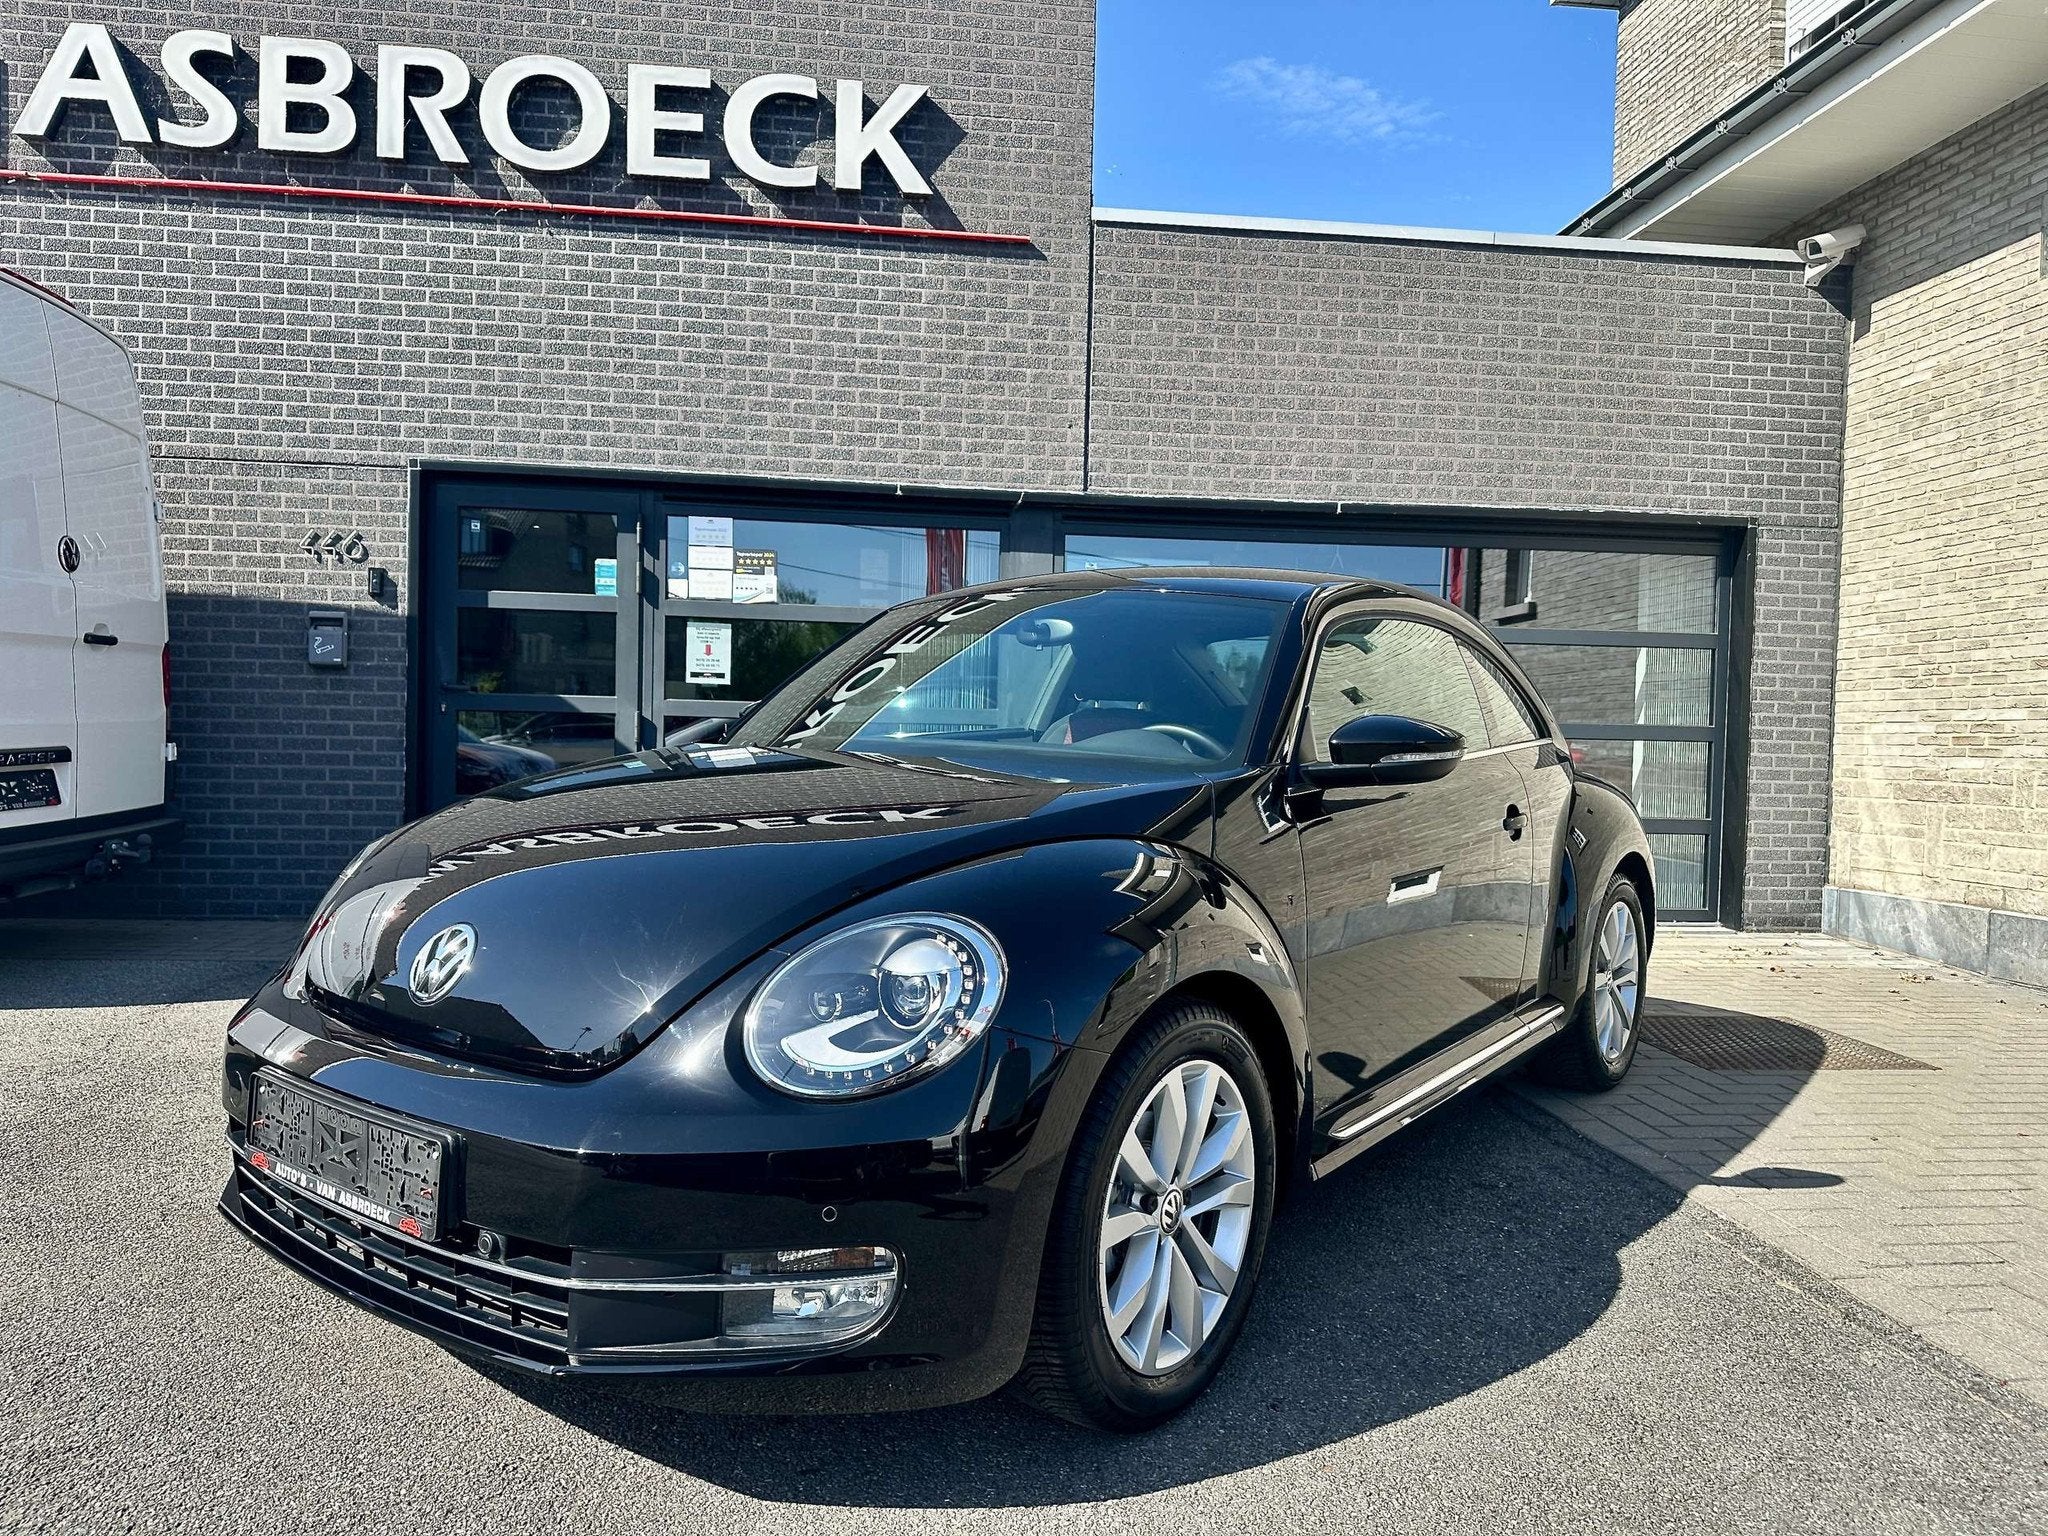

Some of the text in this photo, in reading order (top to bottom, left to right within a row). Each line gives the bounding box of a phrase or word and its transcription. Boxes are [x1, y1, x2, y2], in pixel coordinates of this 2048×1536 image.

[14, 22, 933, 196] ASBROECK
[274, 1162, 307, 1188] AUTO'S
[315, 1177, 337, 1200] VAN
[338, 1190, 392, 1225] ASBROECK
